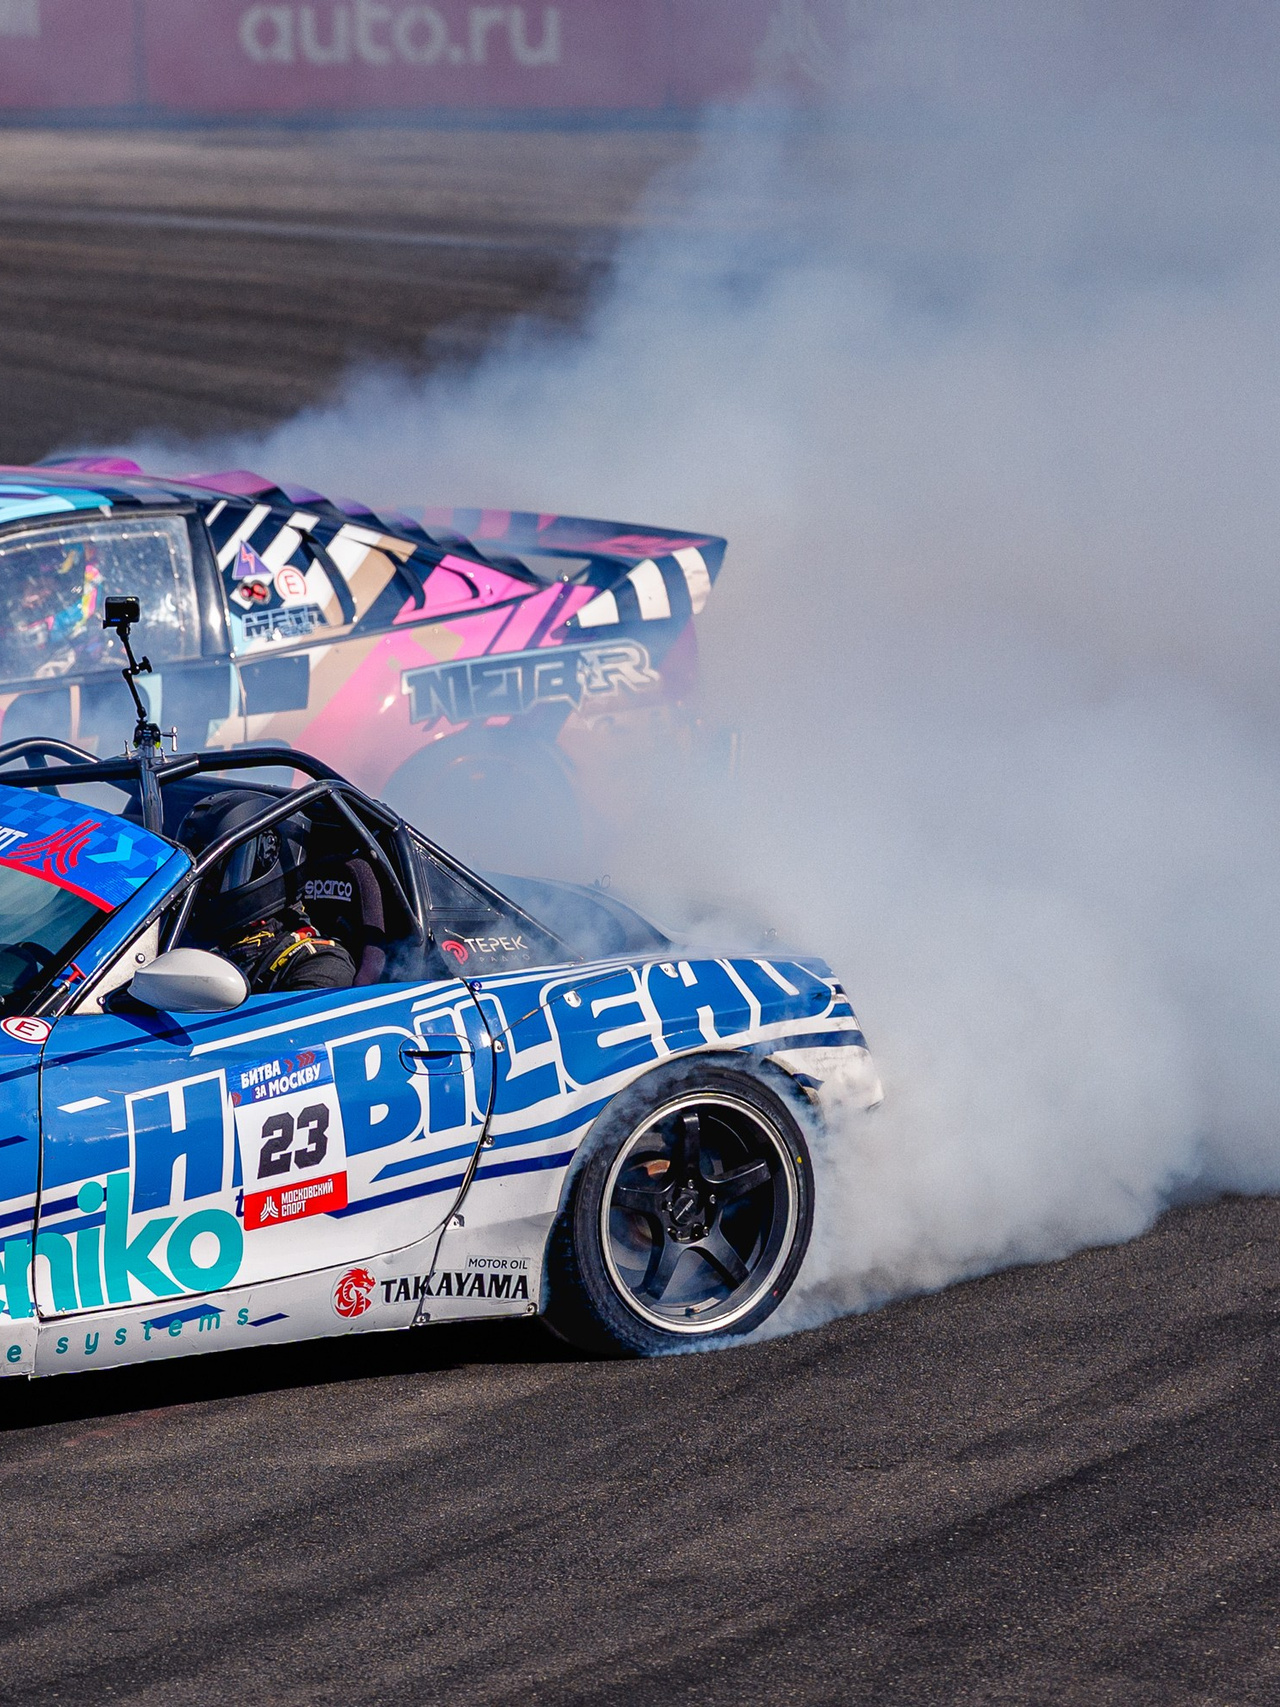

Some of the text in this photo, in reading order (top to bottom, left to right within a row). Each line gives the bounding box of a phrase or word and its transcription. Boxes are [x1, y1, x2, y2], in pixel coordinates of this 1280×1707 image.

[237, 0, 560, 66] auto.ru
[304, 880, 352, 901] sparco
[240, 1059, 281, 1089] БИТВА
[254, 1063, 321, 1099] ЗА МОСКВУ
[257, 1102, 330, 1180] 23
[281, 1179, 334, 1204] МОСКОВСКИЙ
[281, 1200, 307, 1217] СПОРТ
[468, 1258, 528, 1270] MOTOR OIL
[380, 1272, 530, 1304] TAKAYAMA
[56, 1304, 250, 1357] systems
